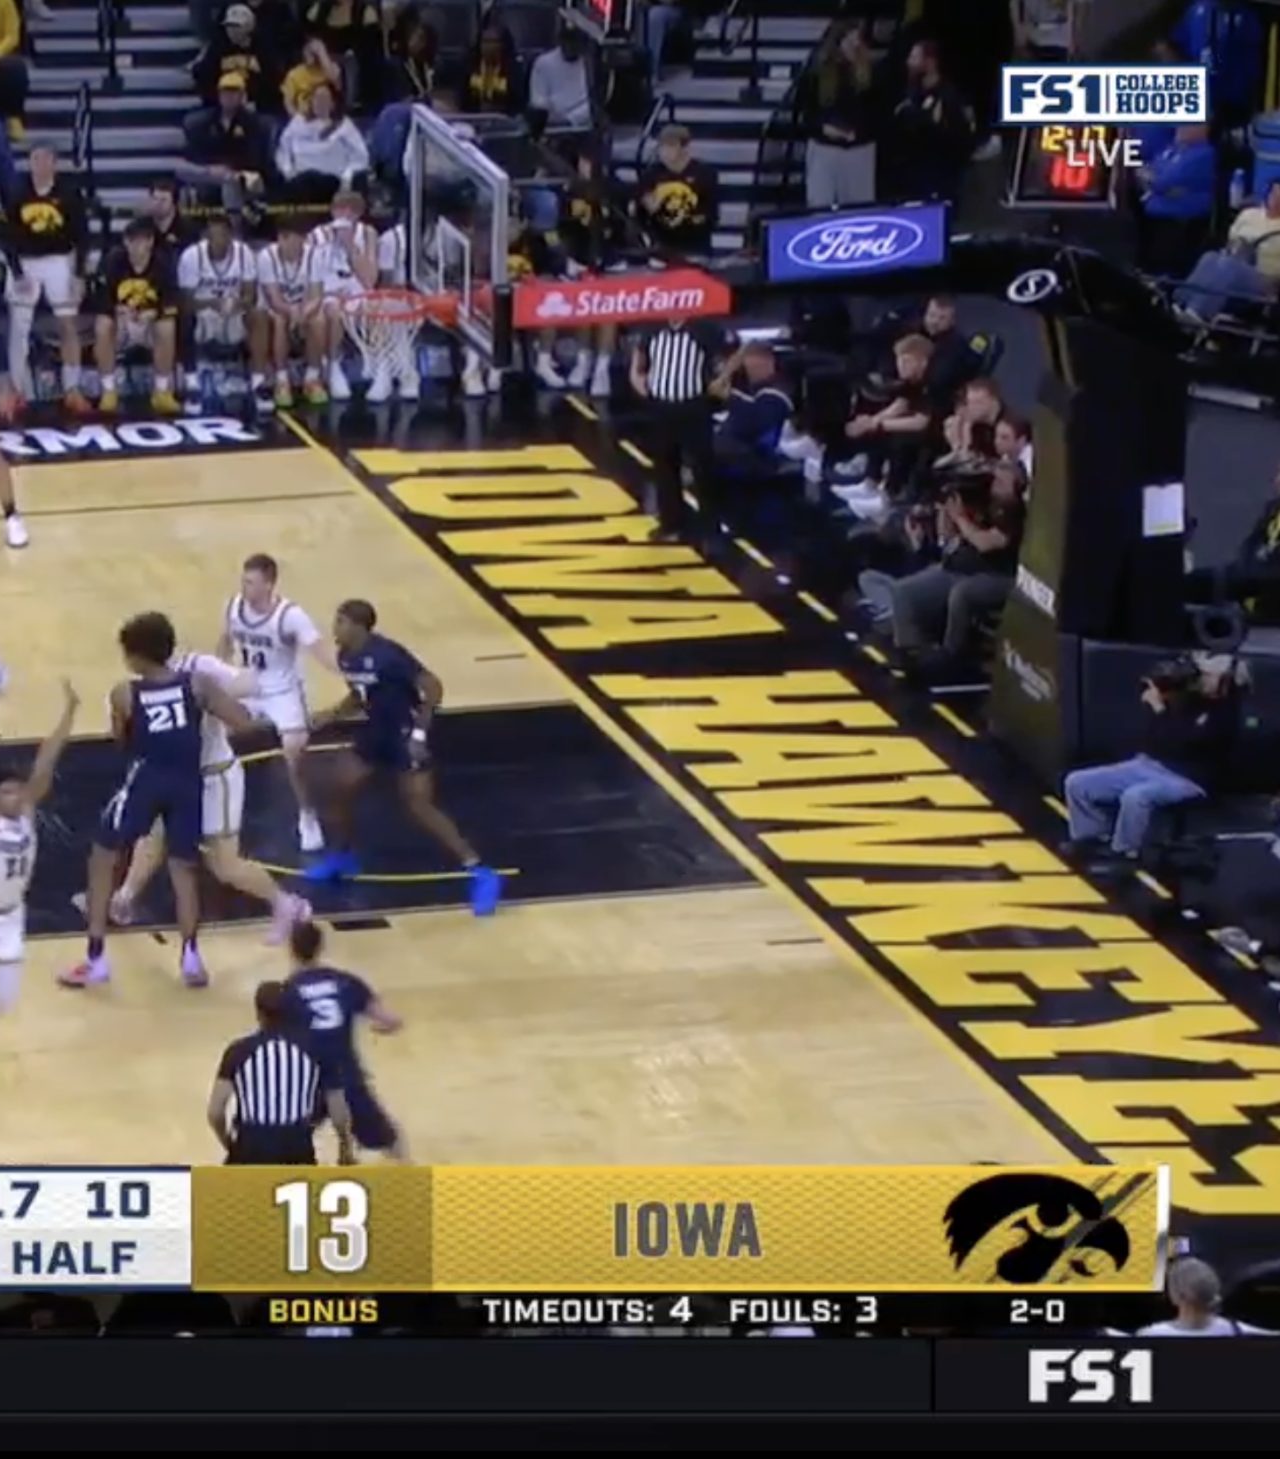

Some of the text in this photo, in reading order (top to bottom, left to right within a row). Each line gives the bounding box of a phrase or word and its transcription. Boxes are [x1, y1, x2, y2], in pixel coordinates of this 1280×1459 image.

[811, 225, 896, 262] Ford
[350, 443, 786, 650] IOWA
[146, 701, 187, 733] 21
[308, 998, 344, 1030] 3
